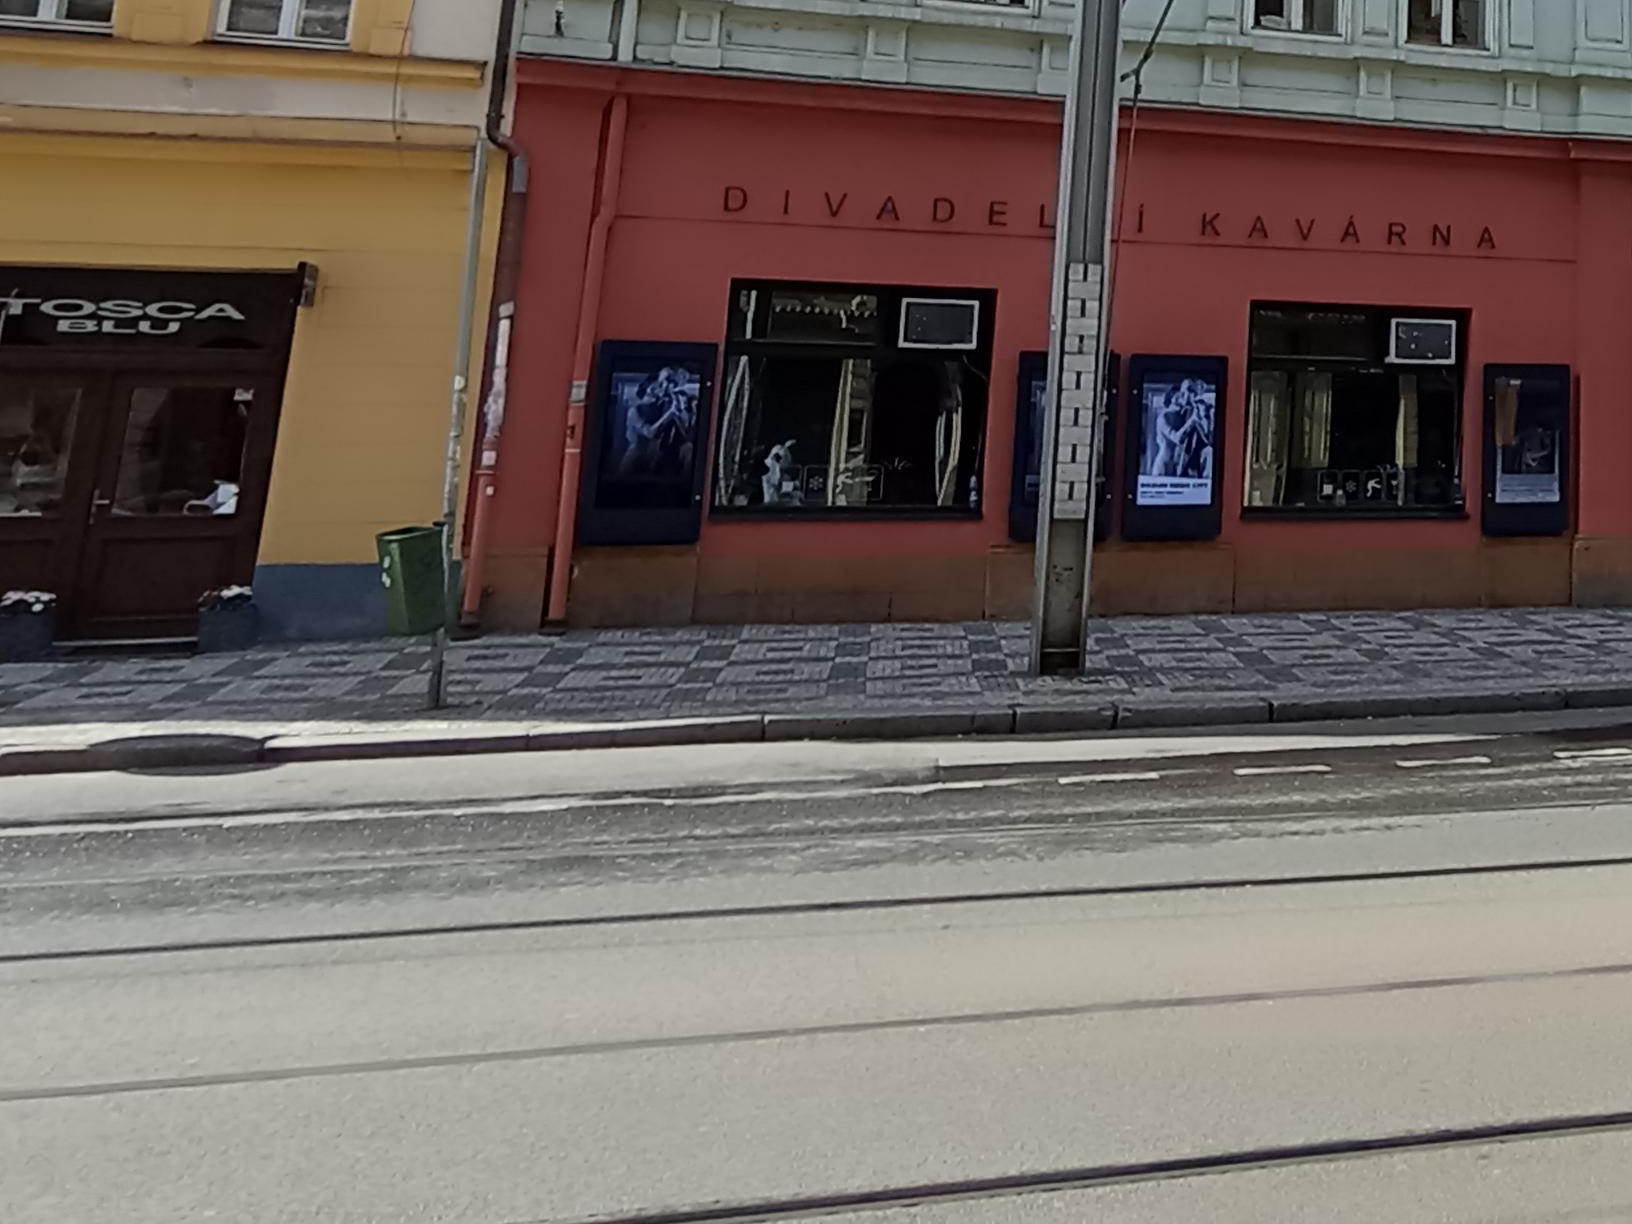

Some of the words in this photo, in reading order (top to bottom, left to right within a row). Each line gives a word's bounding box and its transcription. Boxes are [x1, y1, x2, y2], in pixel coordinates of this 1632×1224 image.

[722, 185, 1144, 234] DIVADELÍ
[1200, 211, 1497, 251] KAVÁRNA
[0, 298, 246, 321] TOSCA
[55, 318, 181, 335] BLU
